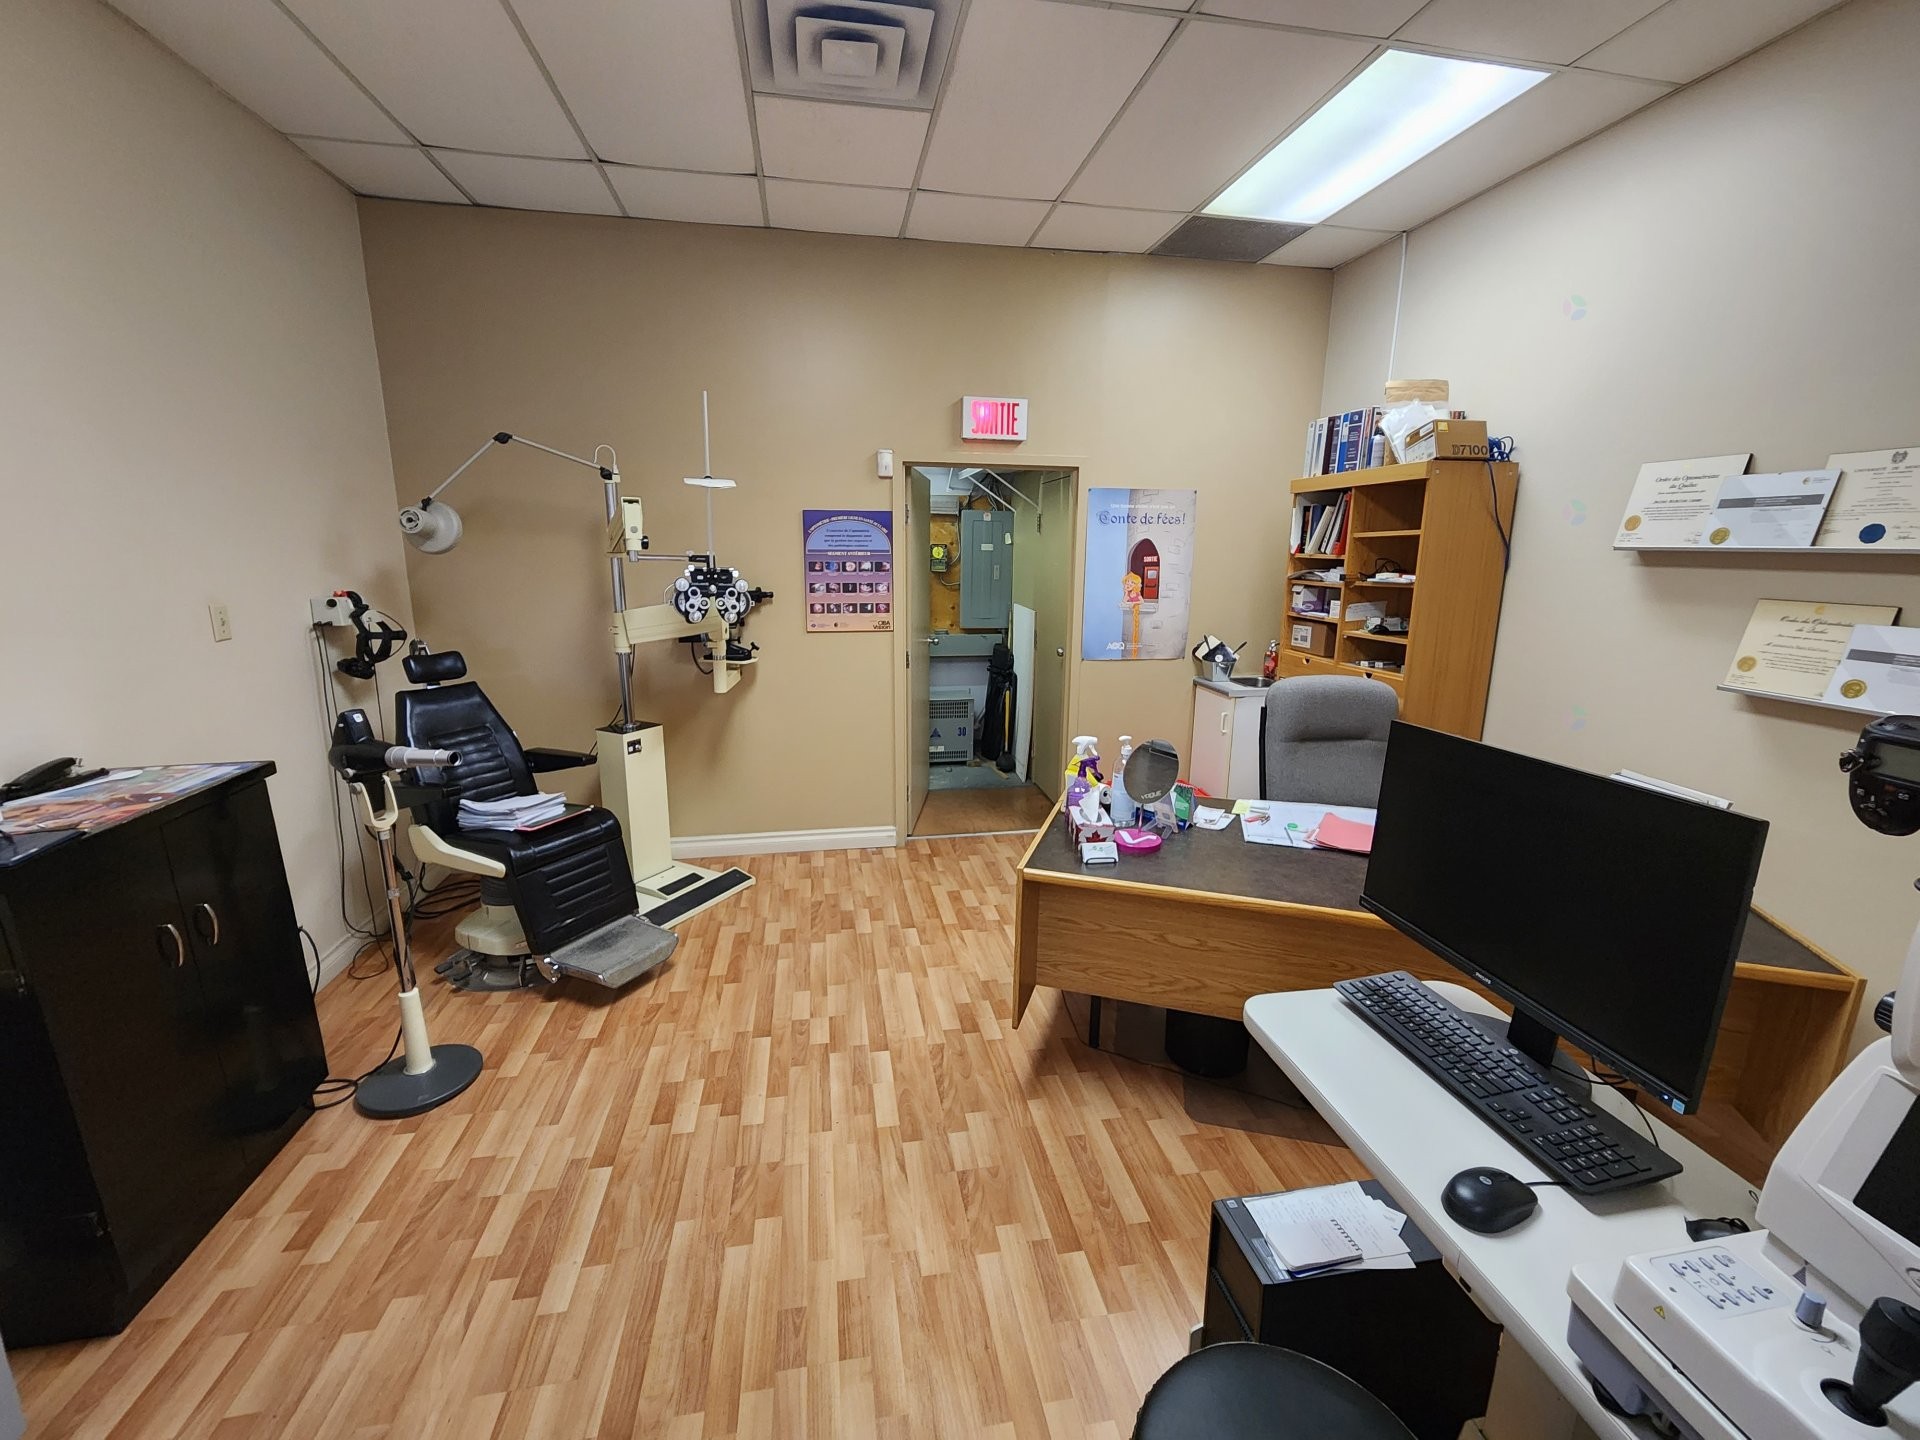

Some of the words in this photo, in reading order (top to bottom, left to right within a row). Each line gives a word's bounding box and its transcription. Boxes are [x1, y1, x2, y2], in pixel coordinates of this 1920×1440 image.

[971, 401, 1020, 436] SORTIE
[1452, 444, 1488, 456] D7100
[1097, 510, 1137, 525] Conte
[1140, 512, 1154, 525] de
[1157, 512, 1186, 525] fées!
[957, 727, 967, 736] 30
